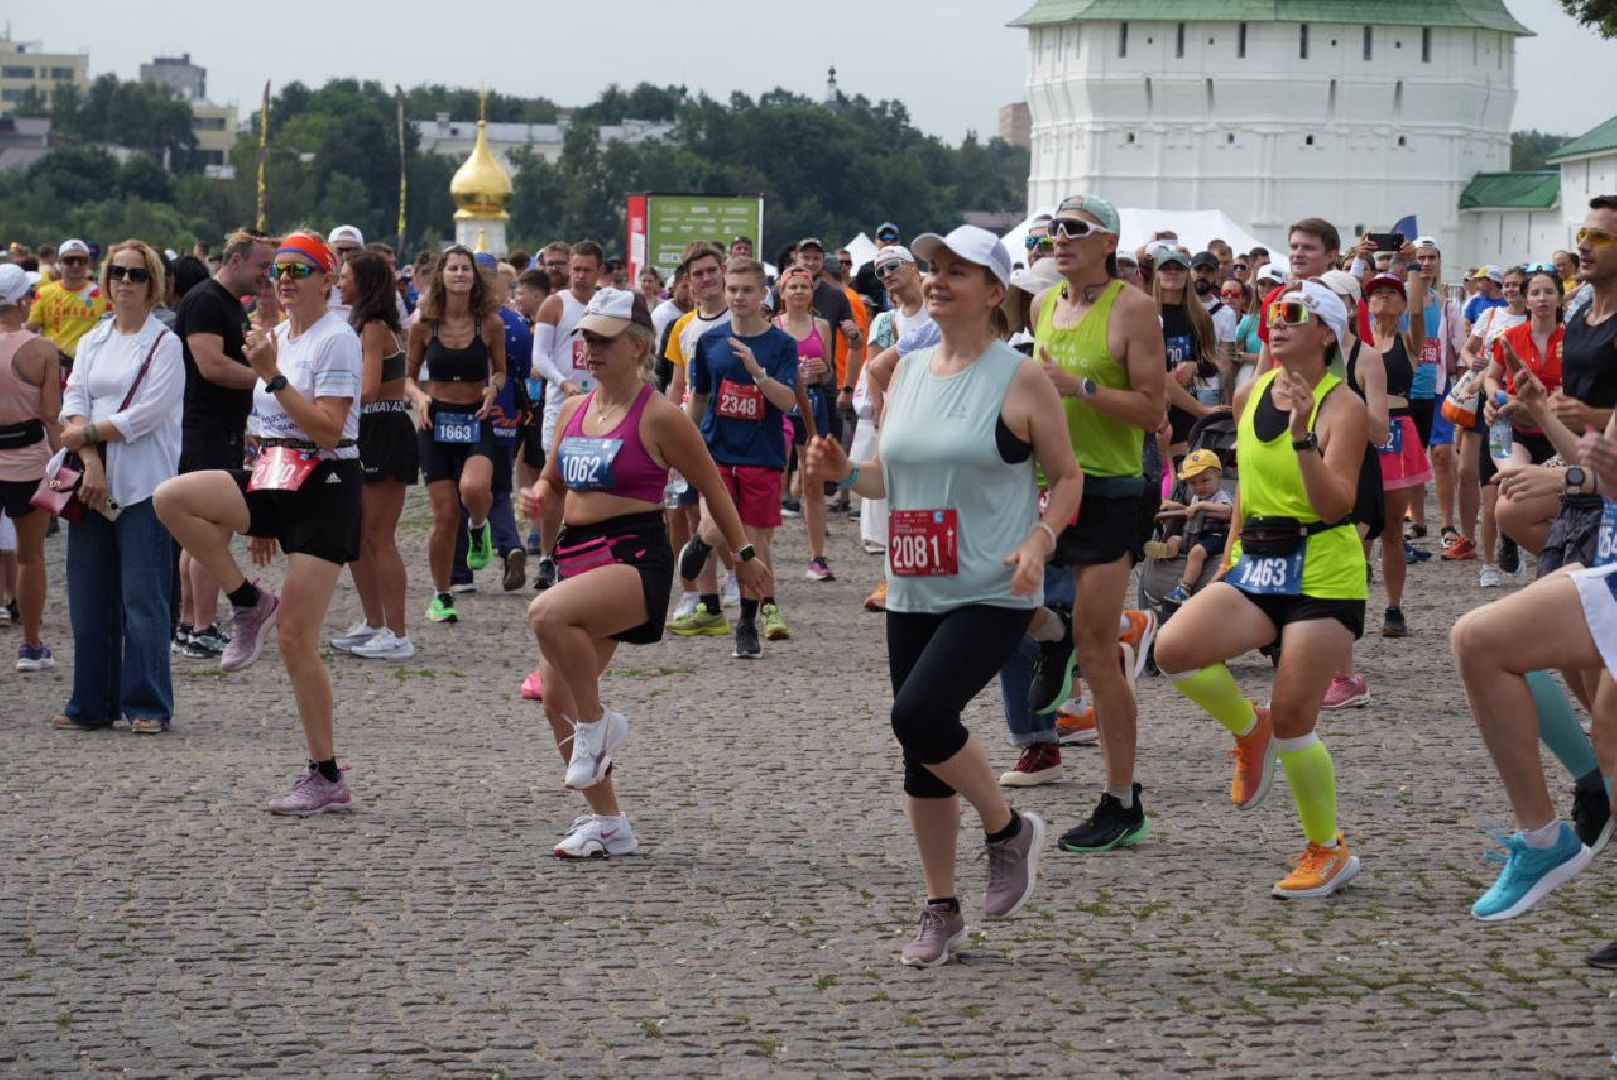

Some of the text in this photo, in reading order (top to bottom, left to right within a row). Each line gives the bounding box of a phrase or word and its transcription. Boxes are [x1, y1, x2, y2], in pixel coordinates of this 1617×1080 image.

[721, 394, 756, 415] 2348
[439, 424, 472, 440] 1663
[562, 455, 600, 482] 1062
[893, 535, 940, 568] 2081
[1240, 557, 1288, 587] 1463
